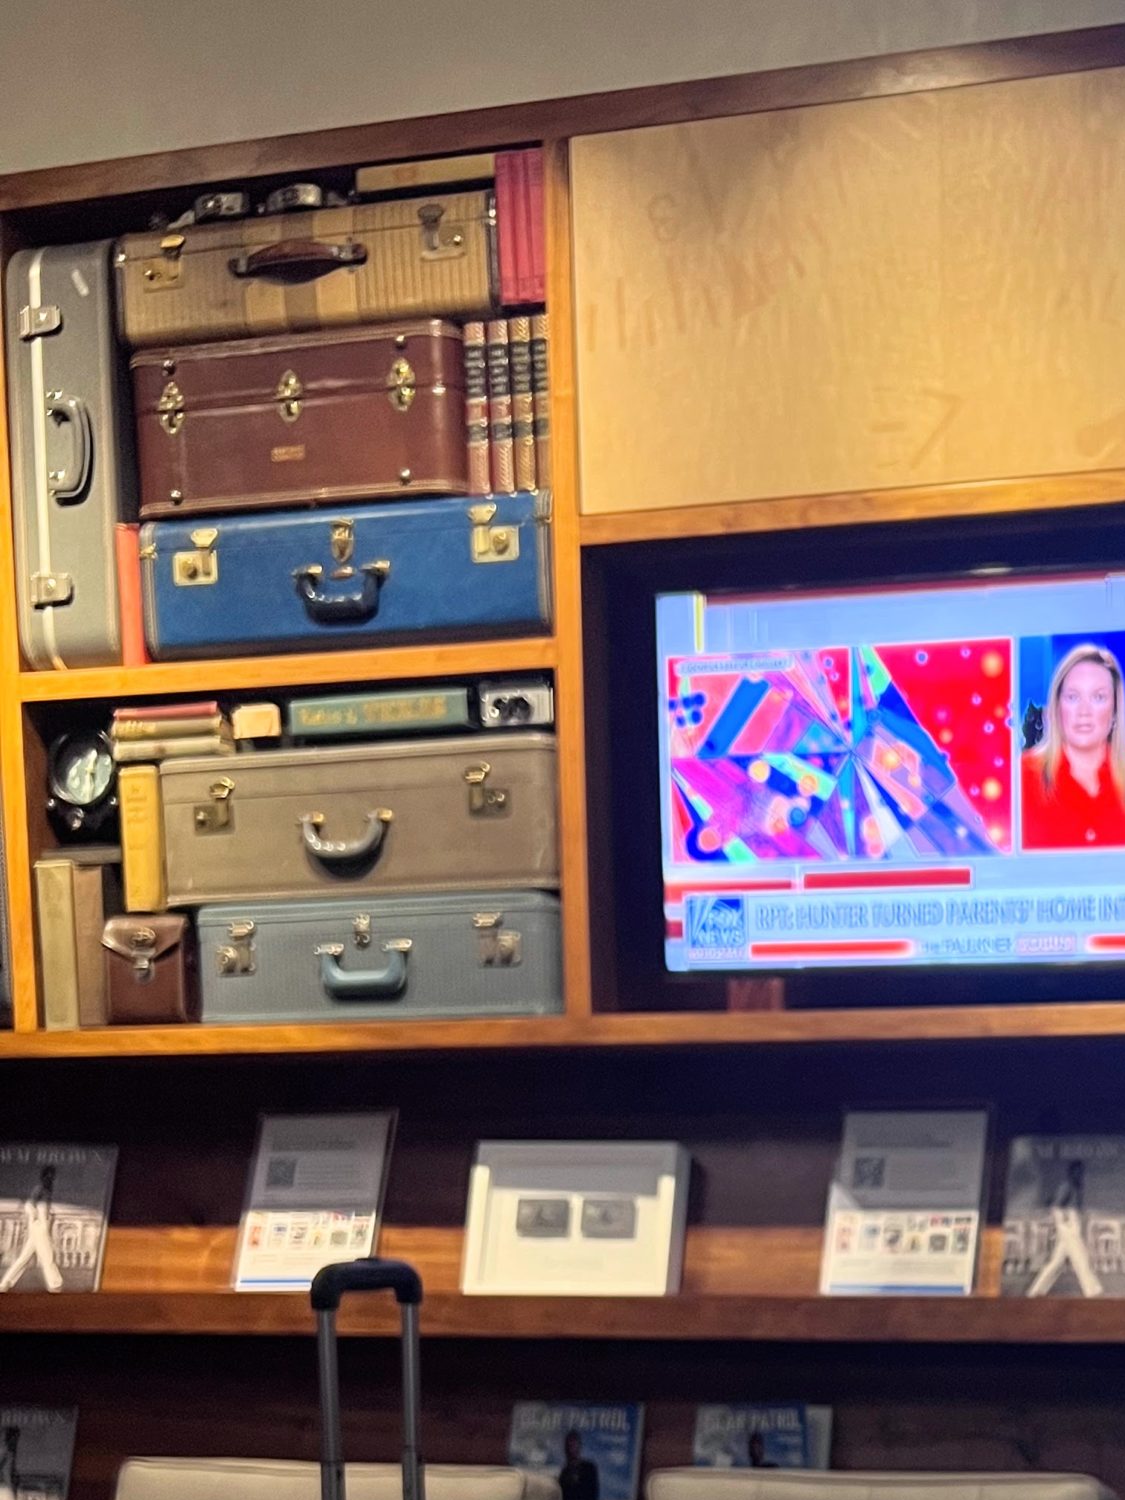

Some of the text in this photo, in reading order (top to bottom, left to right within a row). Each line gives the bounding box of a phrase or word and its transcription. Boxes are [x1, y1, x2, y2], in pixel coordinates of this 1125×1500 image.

[798, 902, 868, 928] HUNTER
[871, 901, 942, 927] TURNED
[1037, 896, 1095, 923] HOME
